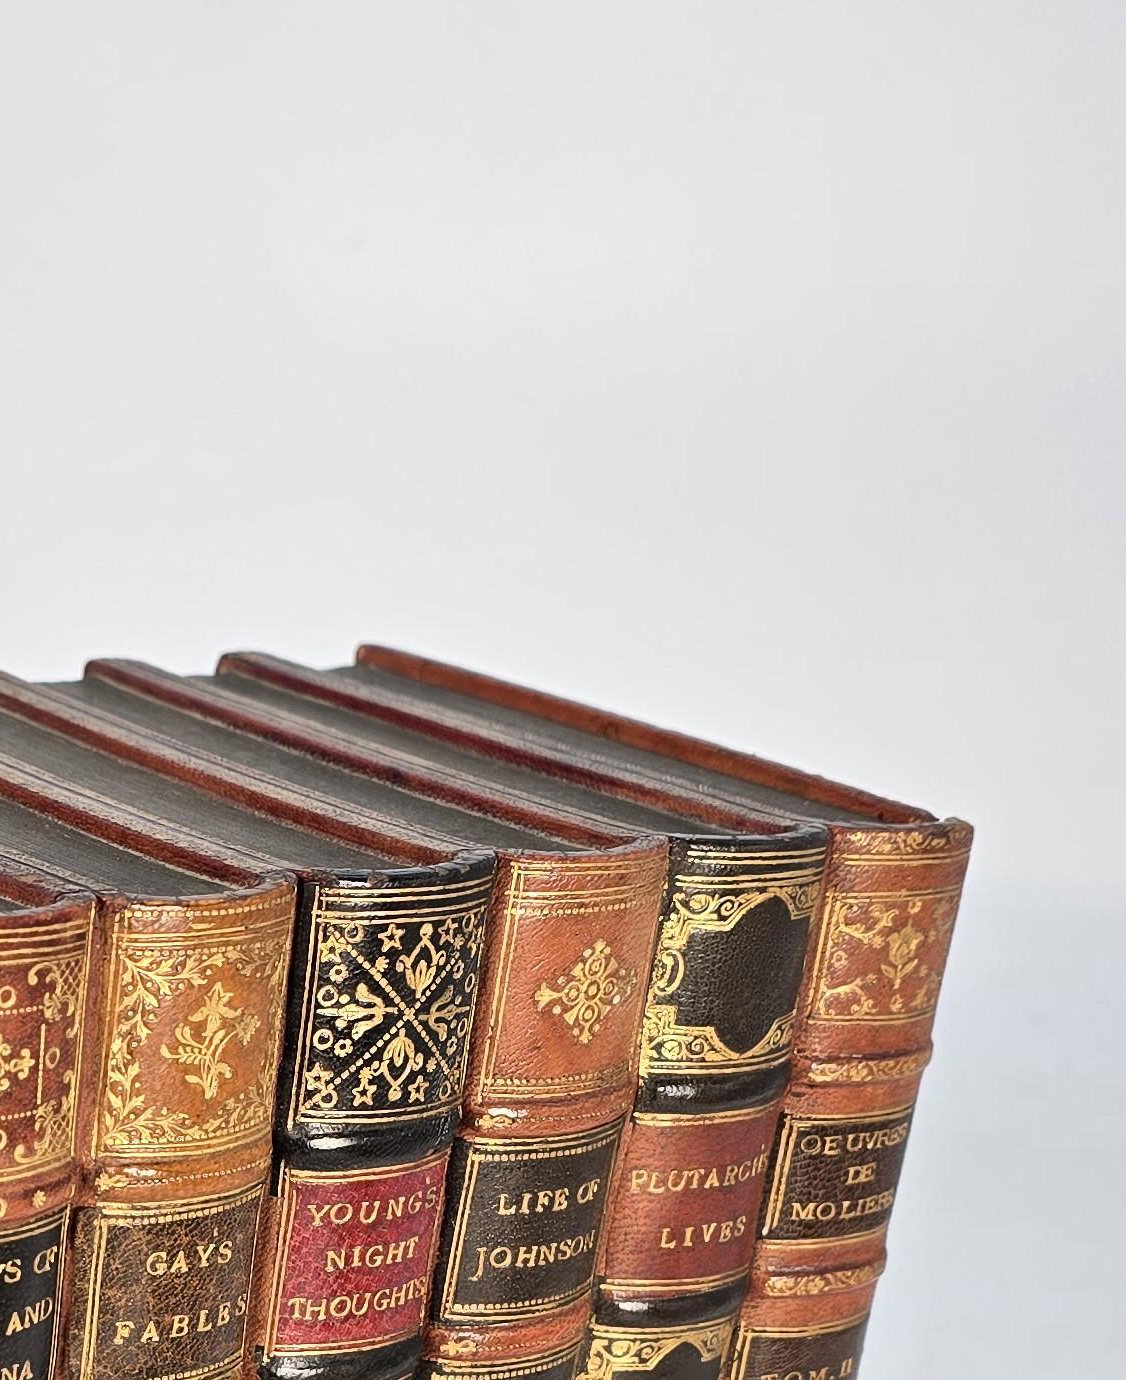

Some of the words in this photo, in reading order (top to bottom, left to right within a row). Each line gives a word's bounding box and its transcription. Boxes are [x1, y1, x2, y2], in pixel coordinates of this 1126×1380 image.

[800, 1122, 909, 1155] OEUVRES
[845, 1162, 877, 1185] DE
[497, 1187, 570, 1216] LIFE
[576, 1178, 601, 1204] OF
[660, 1215, 747, 1249] LIVES
[33, 1245, 58, 1275] OF
[325, 1236, 419, 1273] NIGHT
[468, 1229, 596, 1281] JOHNSON
[5, 1297, 54, 1336] AND
[288, 1276, 427, 1321] THOUGHTS
[113, 1293, 248, 1345] FABLES
